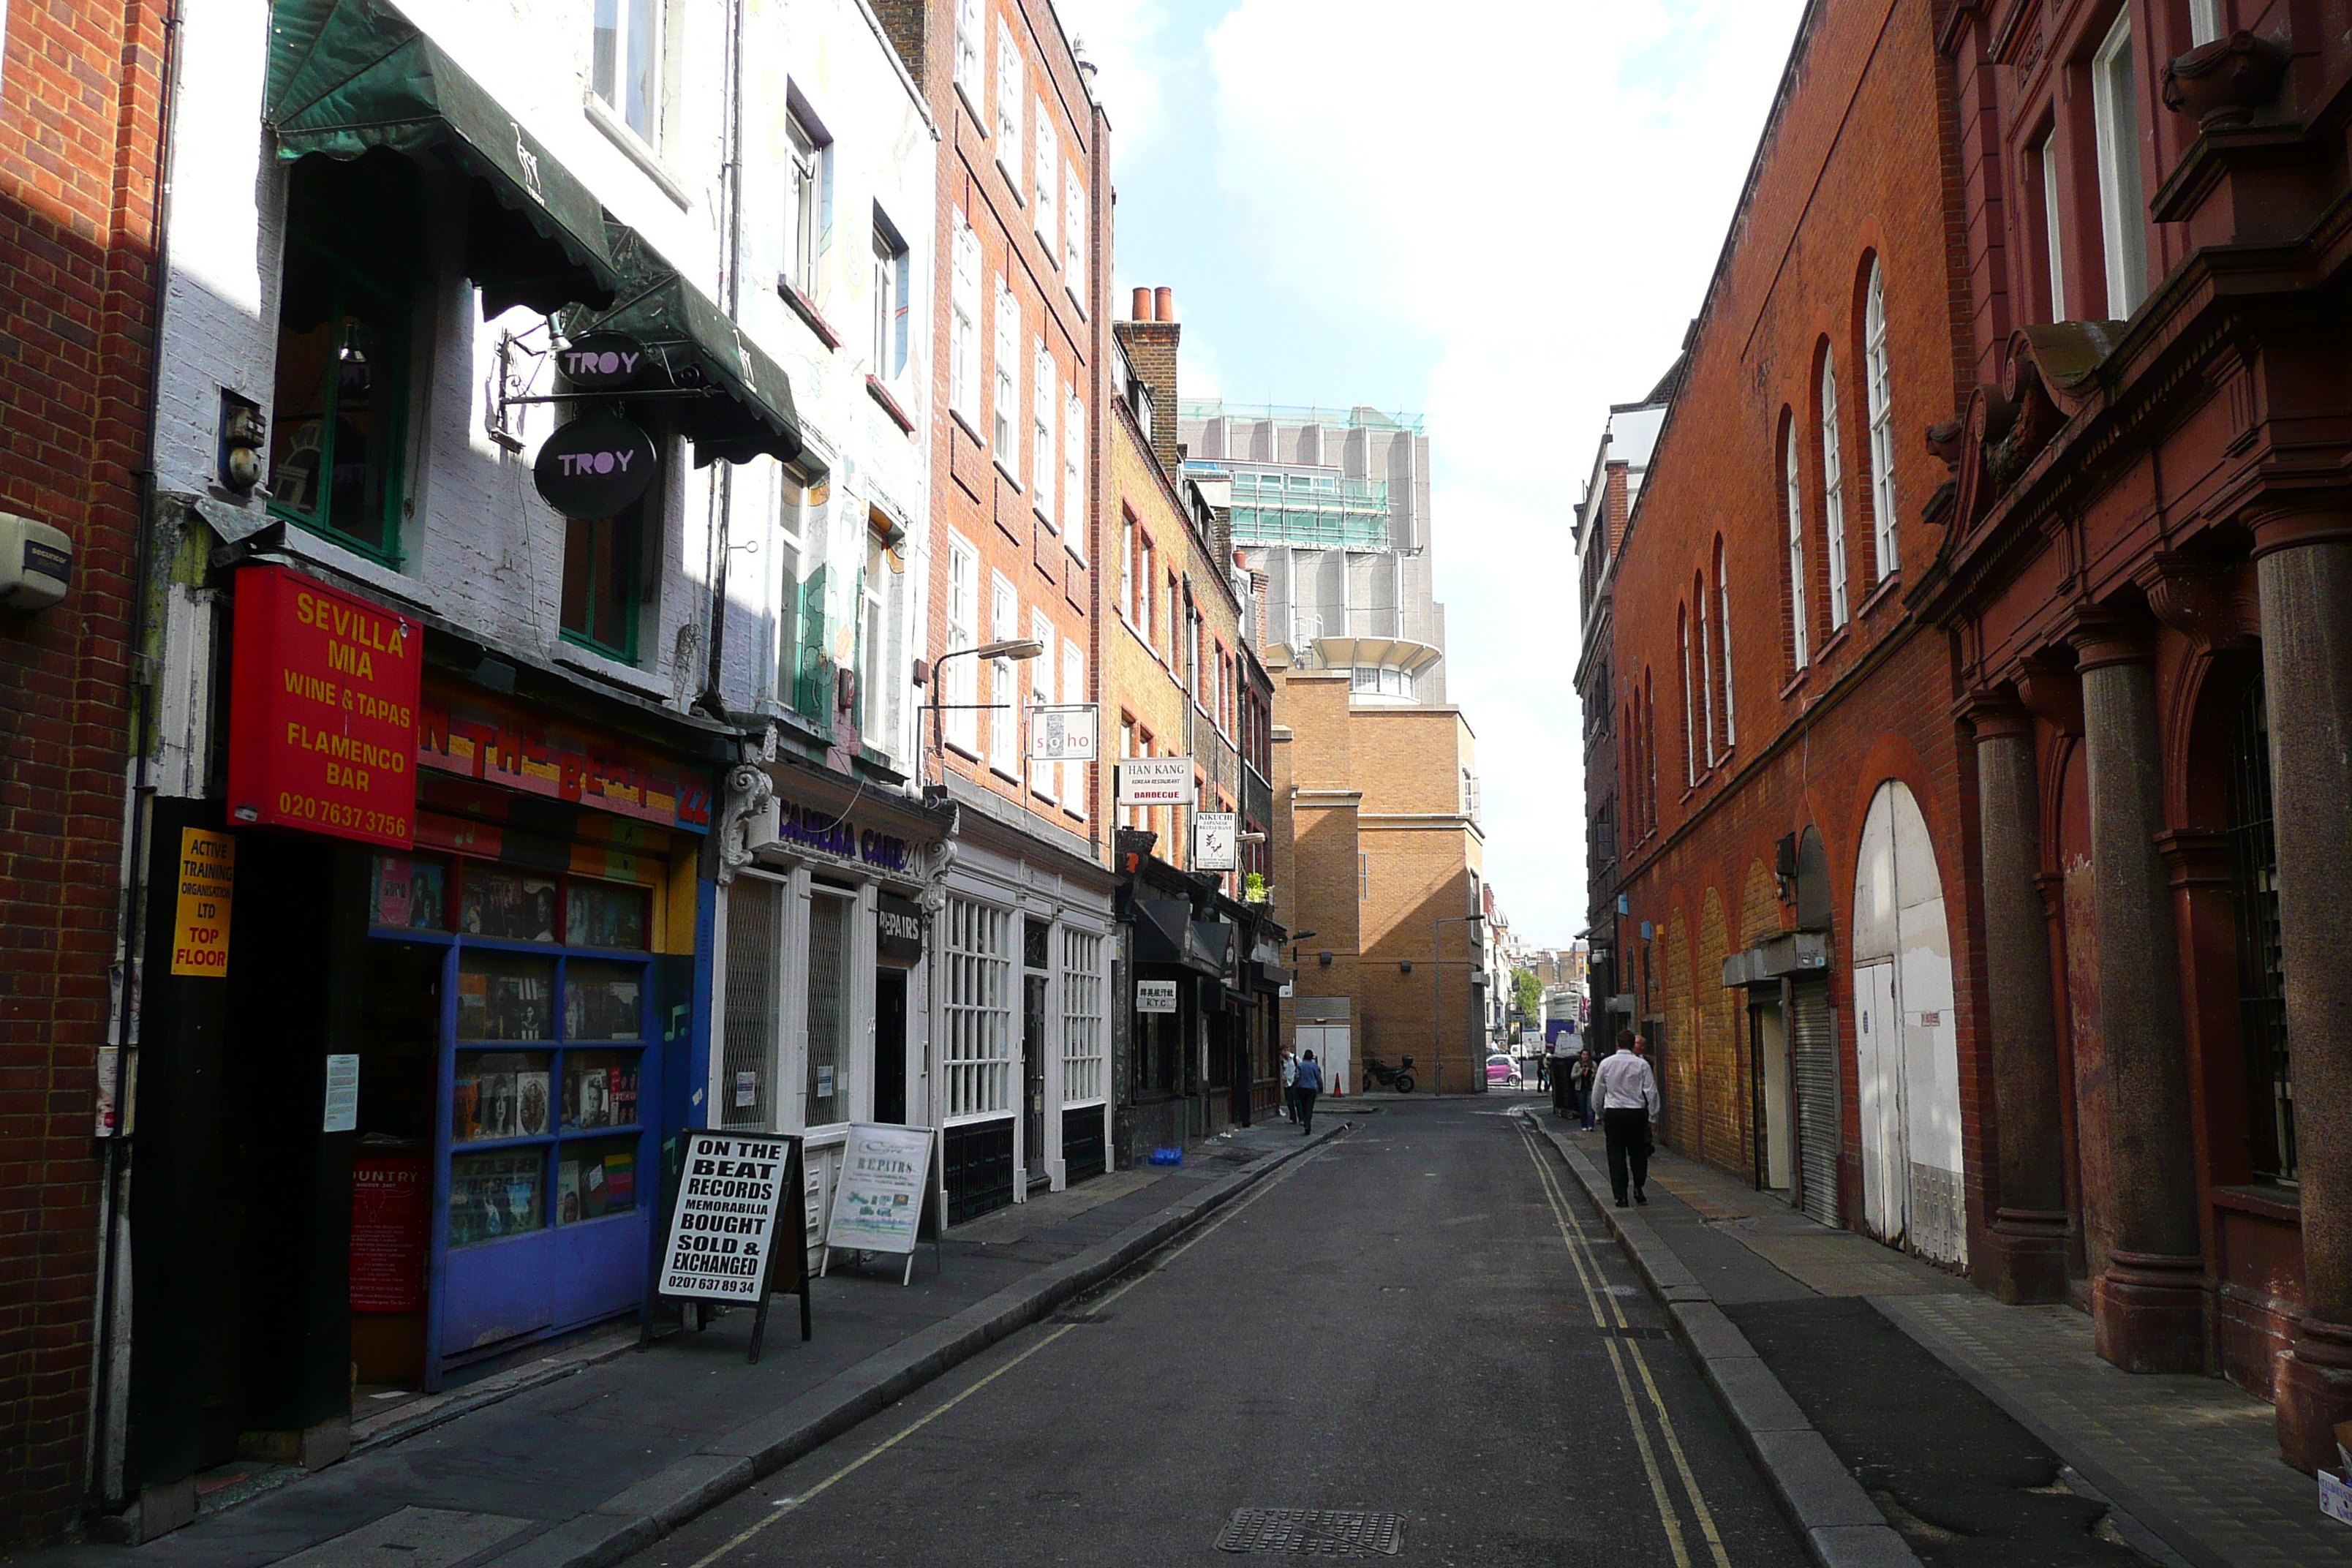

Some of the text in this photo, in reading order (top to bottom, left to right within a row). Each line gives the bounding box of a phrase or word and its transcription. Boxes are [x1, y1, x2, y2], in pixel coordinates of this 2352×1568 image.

[565, 351, 640, 374] TROY
[557, 449, 635, 477] TROY
[297, 592, 404, 658] SEVILLA
[328, 639, 374, 682] MIA
[283, 668, 410, 728] WINE & TAPAS
[287, 722, 404, 774] FLAMENCO
[1036, 732, 1089, 749] soho
[326, 762, 370, 793] BAR
[466, 717, 550, 780] THE
[559, 740, 652, 807] BEAT
[677, 765, 711, 826] 22
[1128, 764, 1184, 775] HAN KANG
[279, 791, 316, 819] 020
[320, 800, 362, 828] 7637
[366, 810, 406, 837] 3756
[190, 839, 227, 859] ACTIVE
[184, 859, 233, 882] TRAINING
[181, 881, 232, 900] ORGANISATION
[197, 902, 216, 919] LTD
[189, 927, 219, 945] TOP
[879, 911, 919, 941] REPAIRS
[175, 948, 226, 967] FLOOR
[697, 1139, 782, 1161] ON THE
[353, 1170, 418, 1183] UNTRY
[692, 1158, 777, 1180] BEAT
[857, 1157, 913, 1175] REPAIRS
[687, 1177, 774, 1201] RECORDS
[685, 1199, 769, 1215] MEMORABILIA
[680, 1213, 766, 1235] BOUGHT
[677, 1235, 761, 1256] SOLD &
[671, 1251, 758, 1276] EXCHANGED
[668, 1275, 755, 1294] 0207 637 89 34
